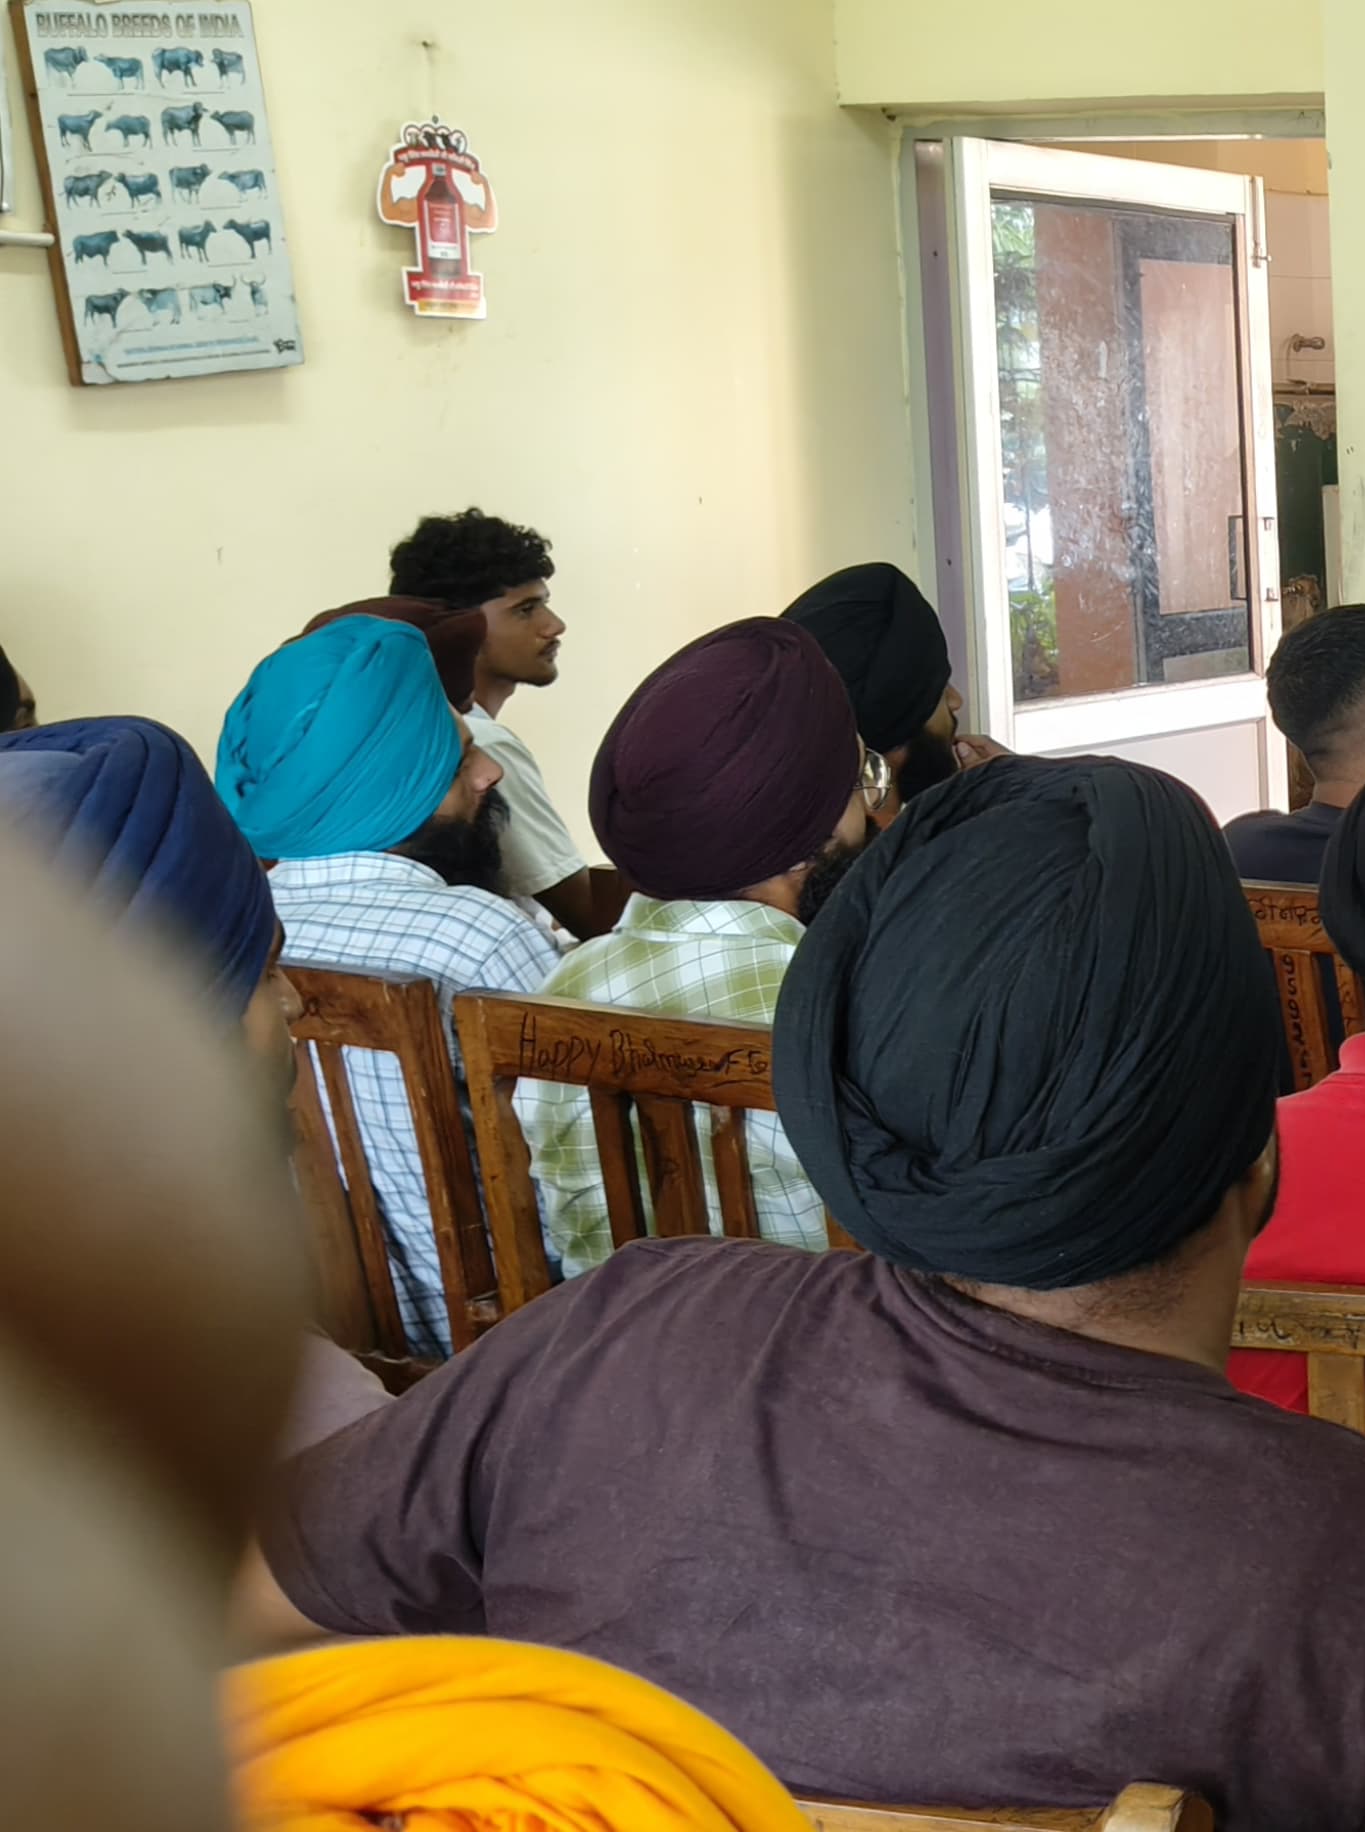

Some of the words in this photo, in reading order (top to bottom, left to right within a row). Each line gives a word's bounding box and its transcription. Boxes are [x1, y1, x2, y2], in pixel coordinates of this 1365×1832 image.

[35, 12, 109, 38] BUFFALO
[110, 12, 173, 38] BREEDS
[174, 12, 196, 38] OF
[198, 12, 245, 38] INDIA
